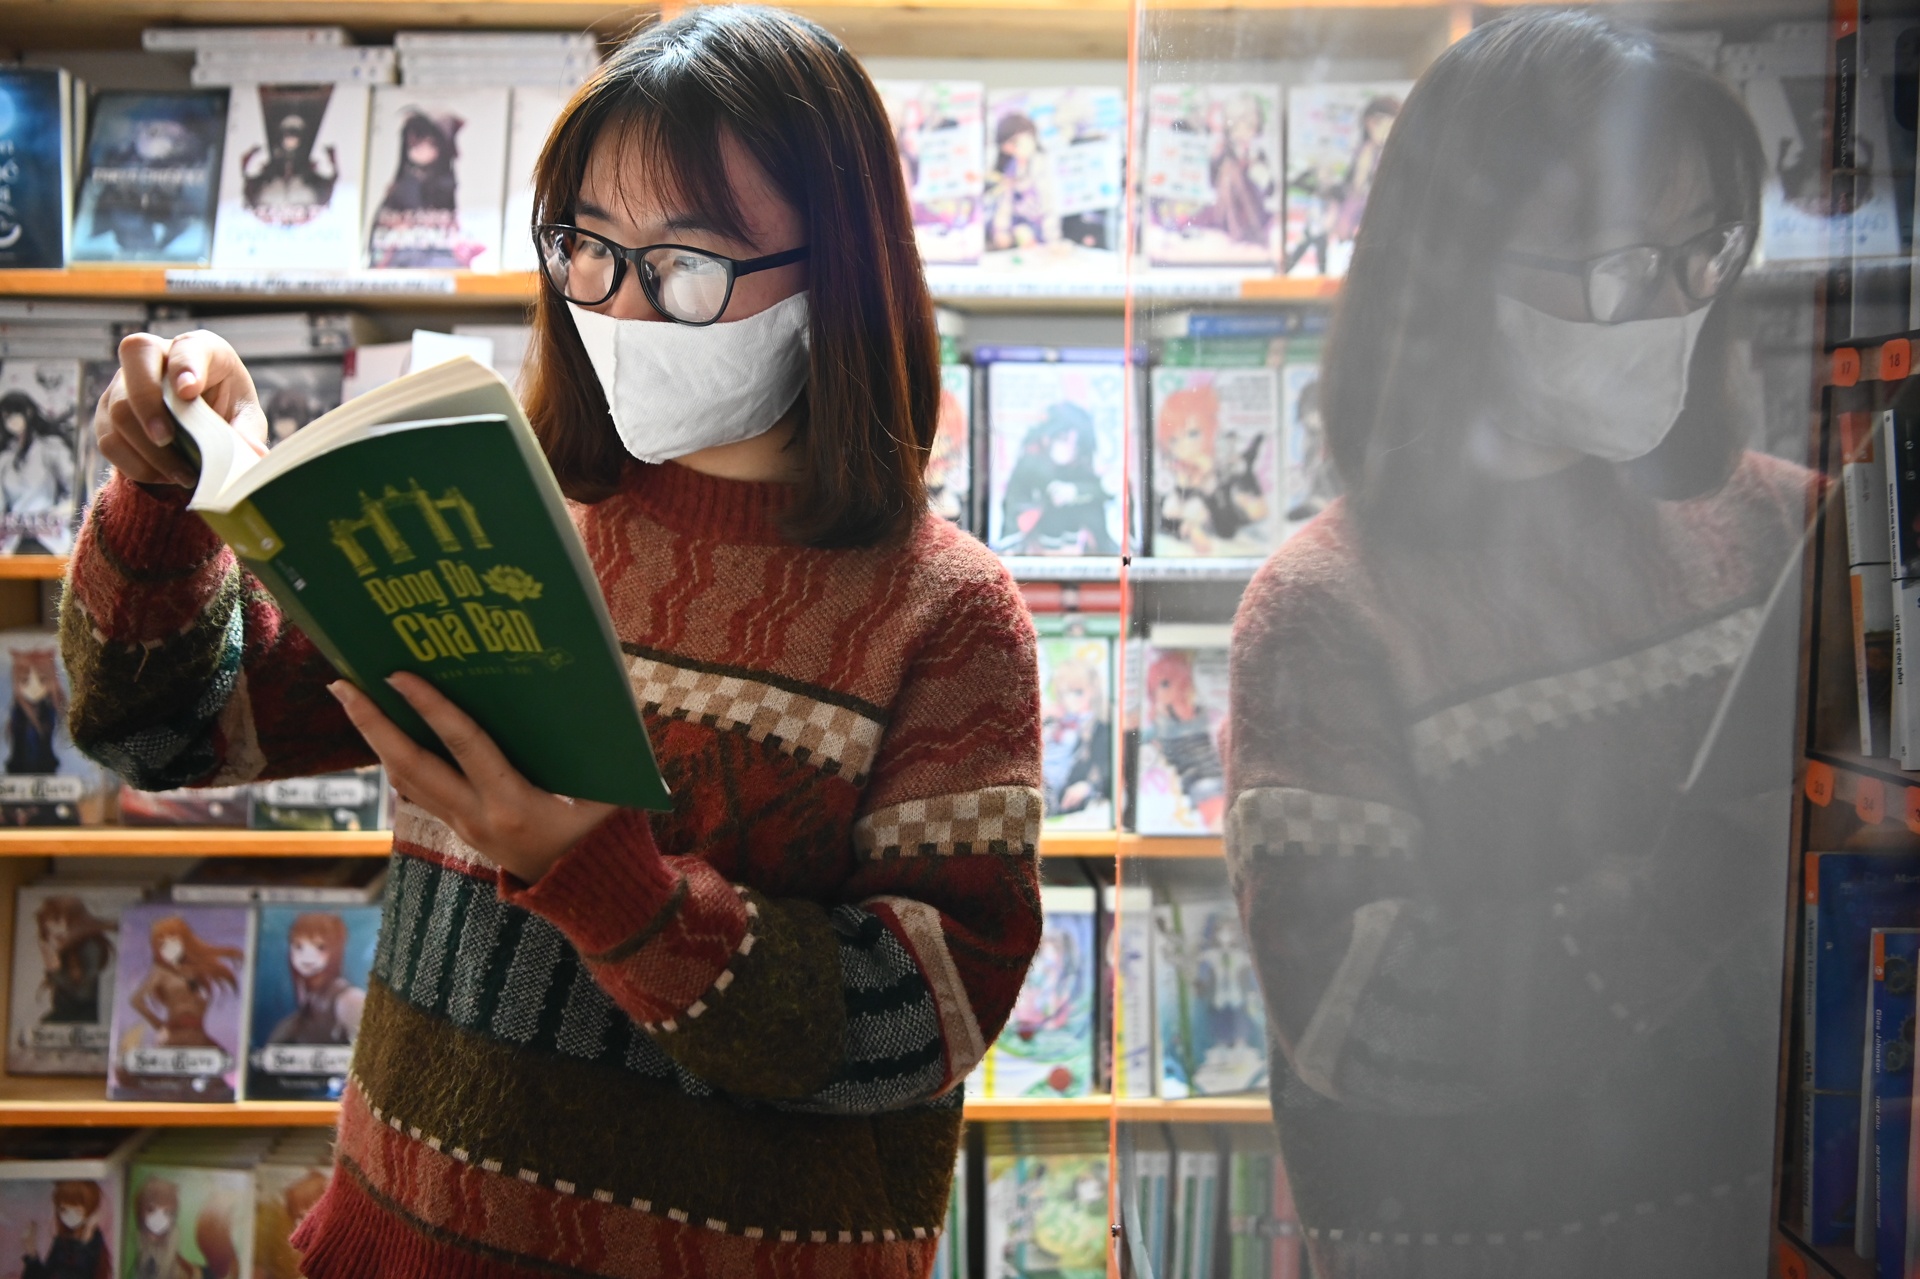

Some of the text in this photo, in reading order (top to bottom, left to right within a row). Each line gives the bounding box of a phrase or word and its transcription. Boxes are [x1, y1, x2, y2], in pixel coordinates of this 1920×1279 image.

[1841, 361, 1852, 375] 17
[1889, 352, 1901, 368] 18
[1875, 1009, 1883, 1073] Giles Johnston
